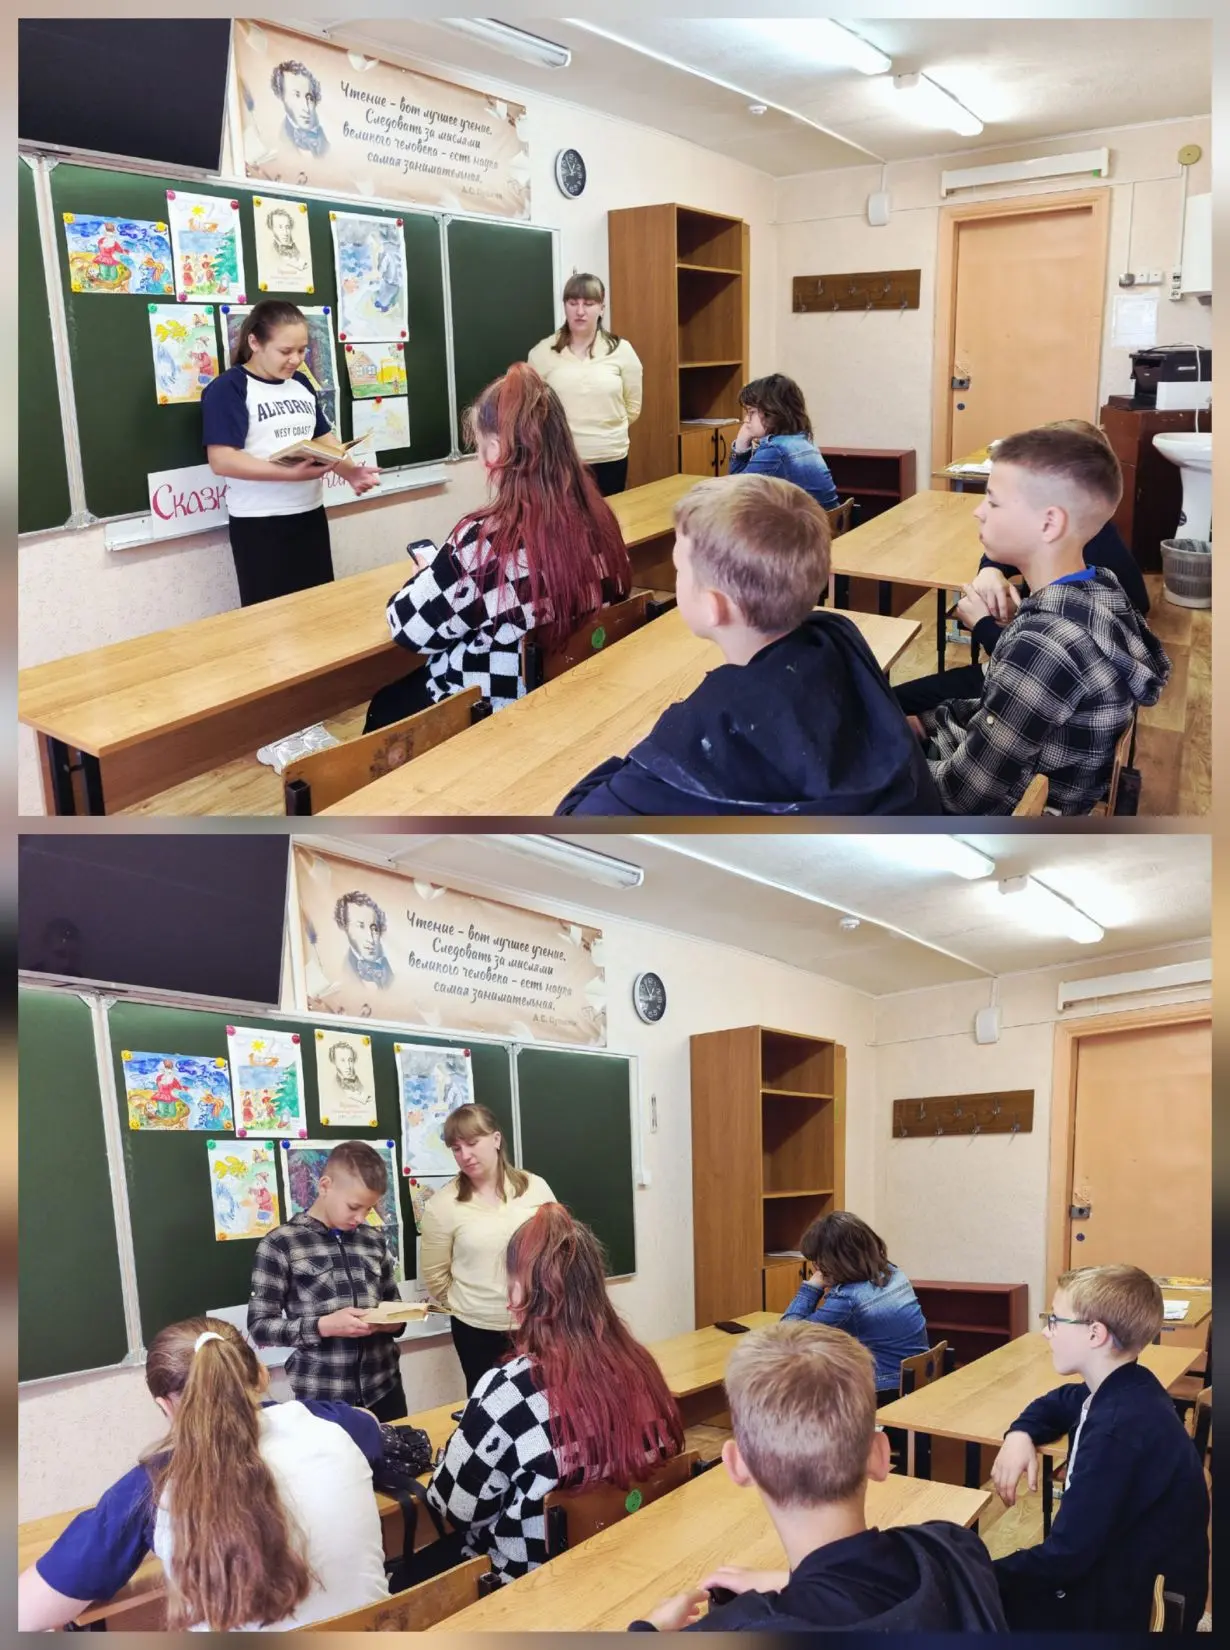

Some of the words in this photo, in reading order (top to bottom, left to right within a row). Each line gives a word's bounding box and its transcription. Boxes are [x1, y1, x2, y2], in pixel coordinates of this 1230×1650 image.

[341, 80, 387, 107] Чтение
[400, 96, 421, 116] вот
[423, 109, 458, 126] лучшее
[343, 121, 391, 148] великого
[395, 138, 438, 157] человека
[449, 151, 471, 164] есть
[365, 107, 422, 134] Следовать
[424, 128, 435, 142] за
[367, 151, 401, 168] самая
[273, 427, 291, 439] WEST
[292, 425, 311, 437] COAST
[152, 483, 229, 521] Сказк
[406, 909, 455, 936] Чтение
[468, 923, 490, 944] вот
[493, 937, 529, 953] лучшее
[408, 950, 459, 976] великого
[463, 966, 508, 985] человека
[520, 978, 543, 991] есть
[432, 937, 492, 963] Следовать
[493, 954, 505, 970] за
[433, 981, 470, 997] самая
